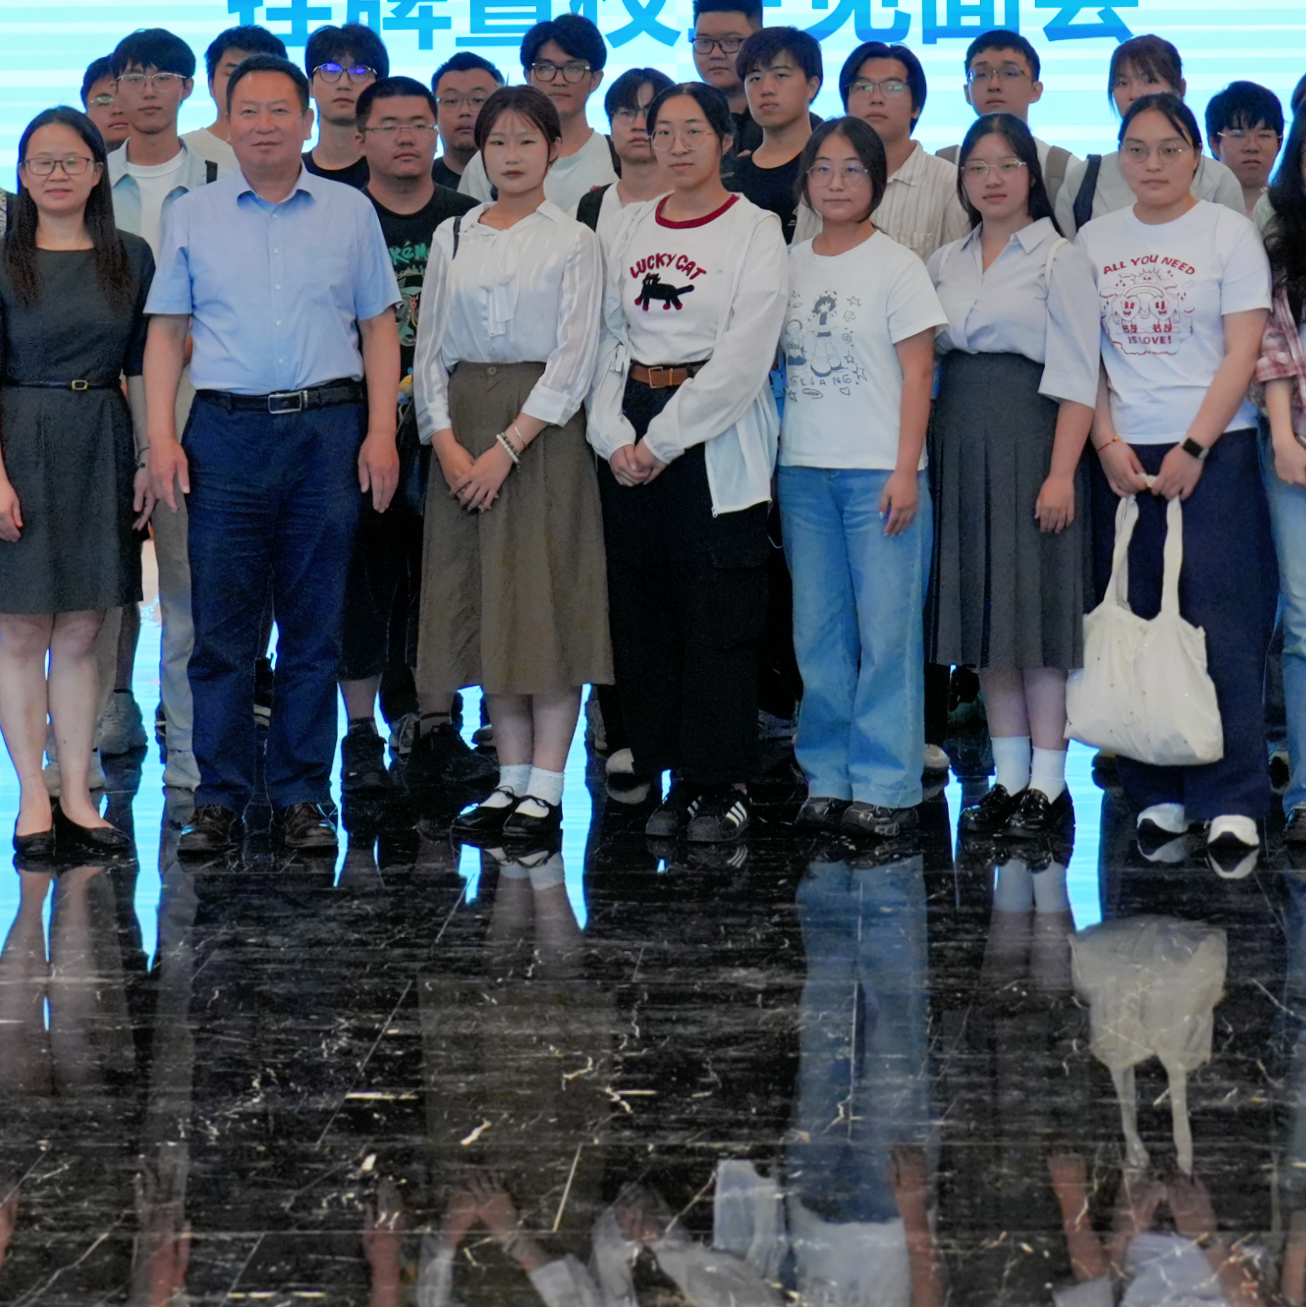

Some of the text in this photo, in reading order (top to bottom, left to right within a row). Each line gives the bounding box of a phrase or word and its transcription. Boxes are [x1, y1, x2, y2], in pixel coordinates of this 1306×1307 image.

[630, 252, 707, 280] LUCKY CAT
[1103, 254, 1196, 275] ALL YOU NEED
[1139, 334, 1173, 345] LOVE!
